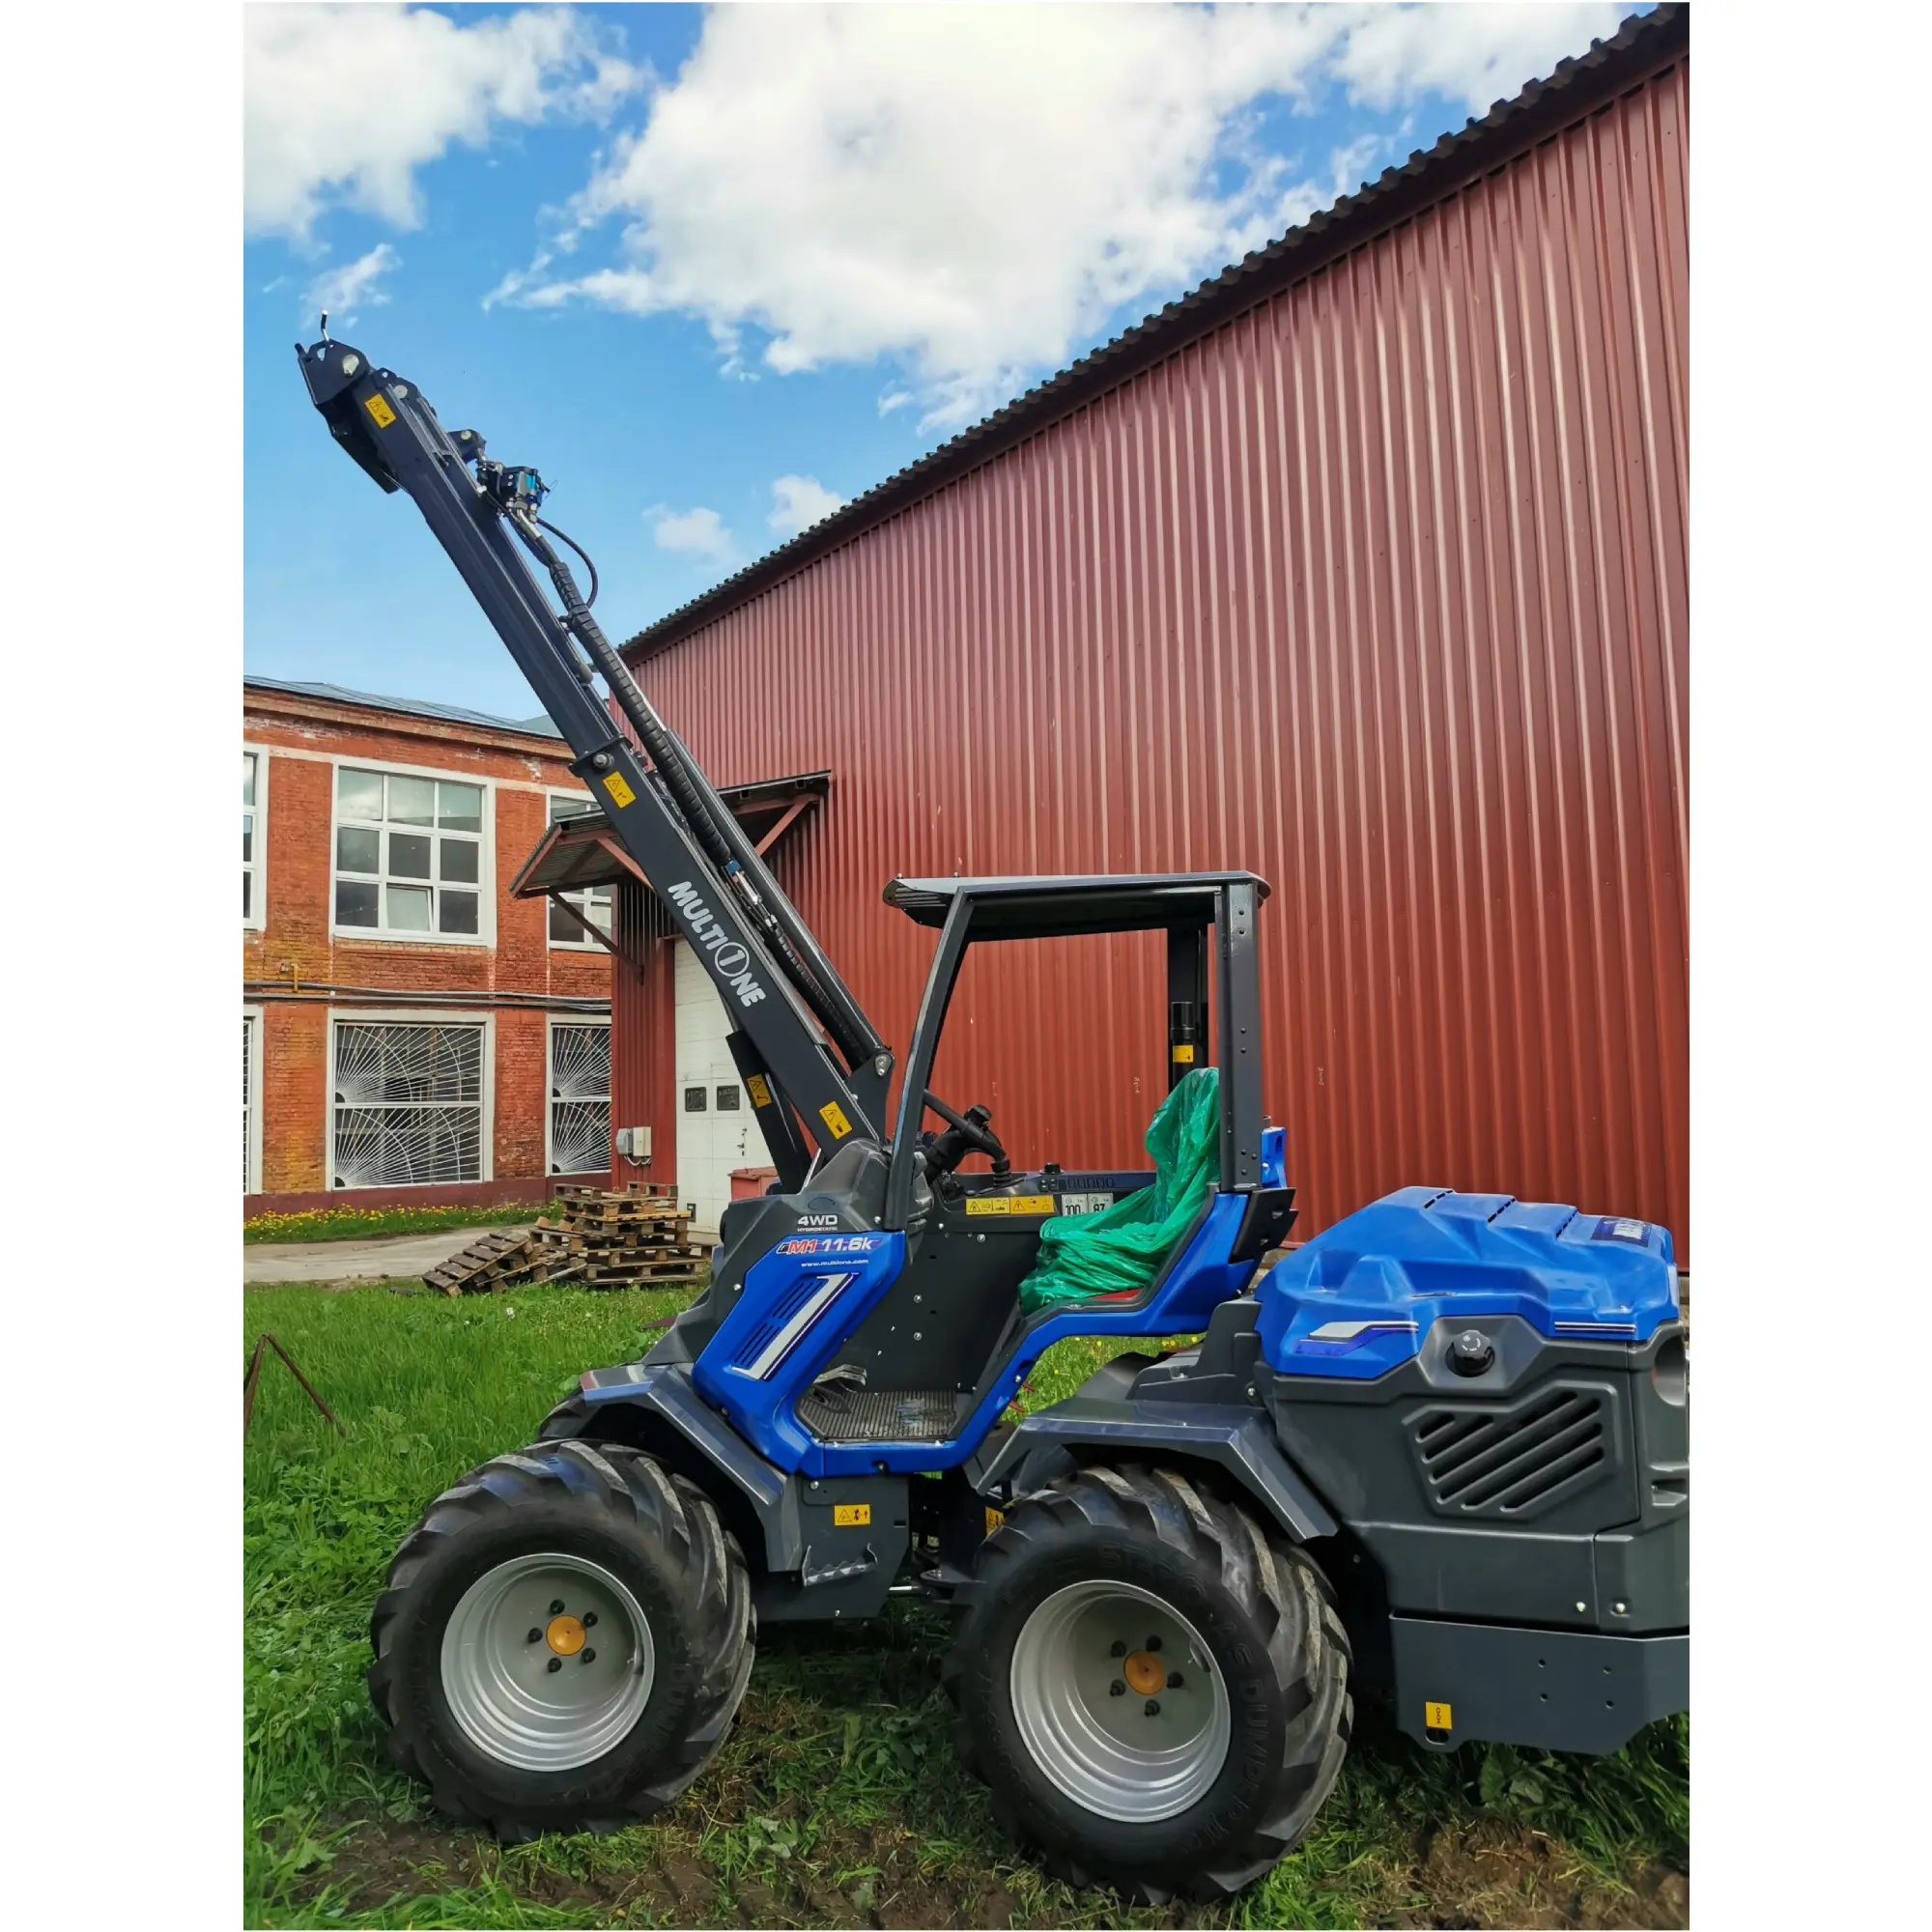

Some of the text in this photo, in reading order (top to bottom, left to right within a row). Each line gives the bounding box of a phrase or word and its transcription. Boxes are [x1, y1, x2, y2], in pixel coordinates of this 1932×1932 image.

[797, 1214, 838, 1226] 4WD
[786, 1236, 873, 1255] M1 11.6k
[801, 1259, 869, 1267] www.multione.com
